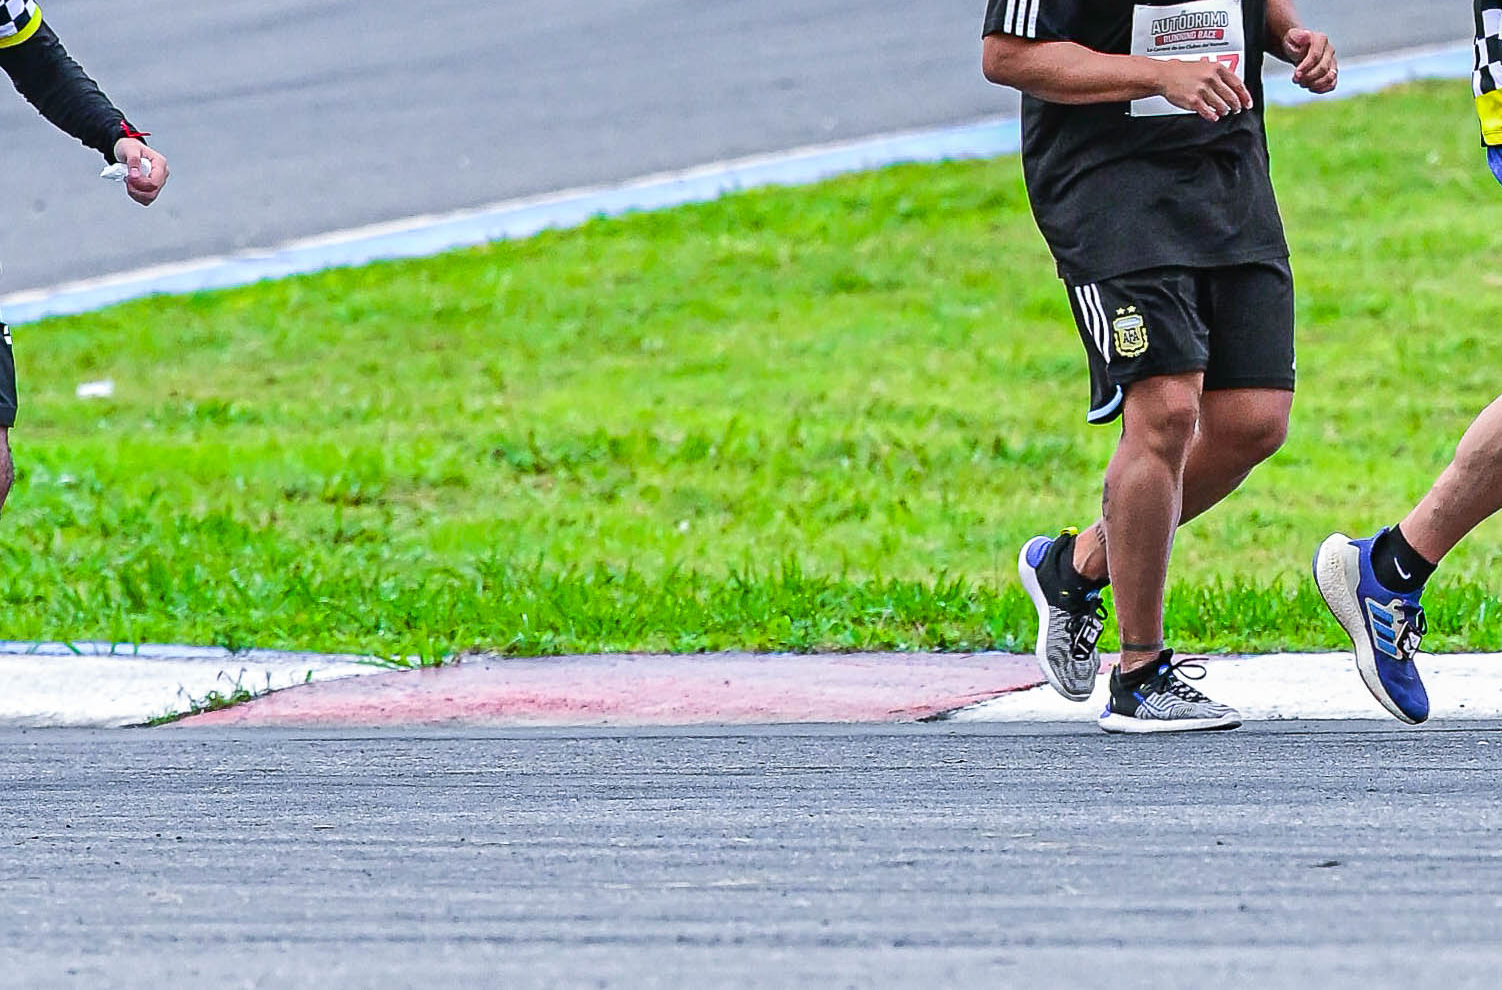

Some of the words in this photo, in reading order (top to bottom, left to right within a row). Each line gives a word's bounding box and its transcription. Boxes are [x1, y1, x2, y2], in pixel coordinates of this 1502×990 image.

[1151, 10, 1229, 36] AUTÓDROMO
[1163, 30, 1197, 44] RUNNING
[1197, 30, 1217, 40] RACE
